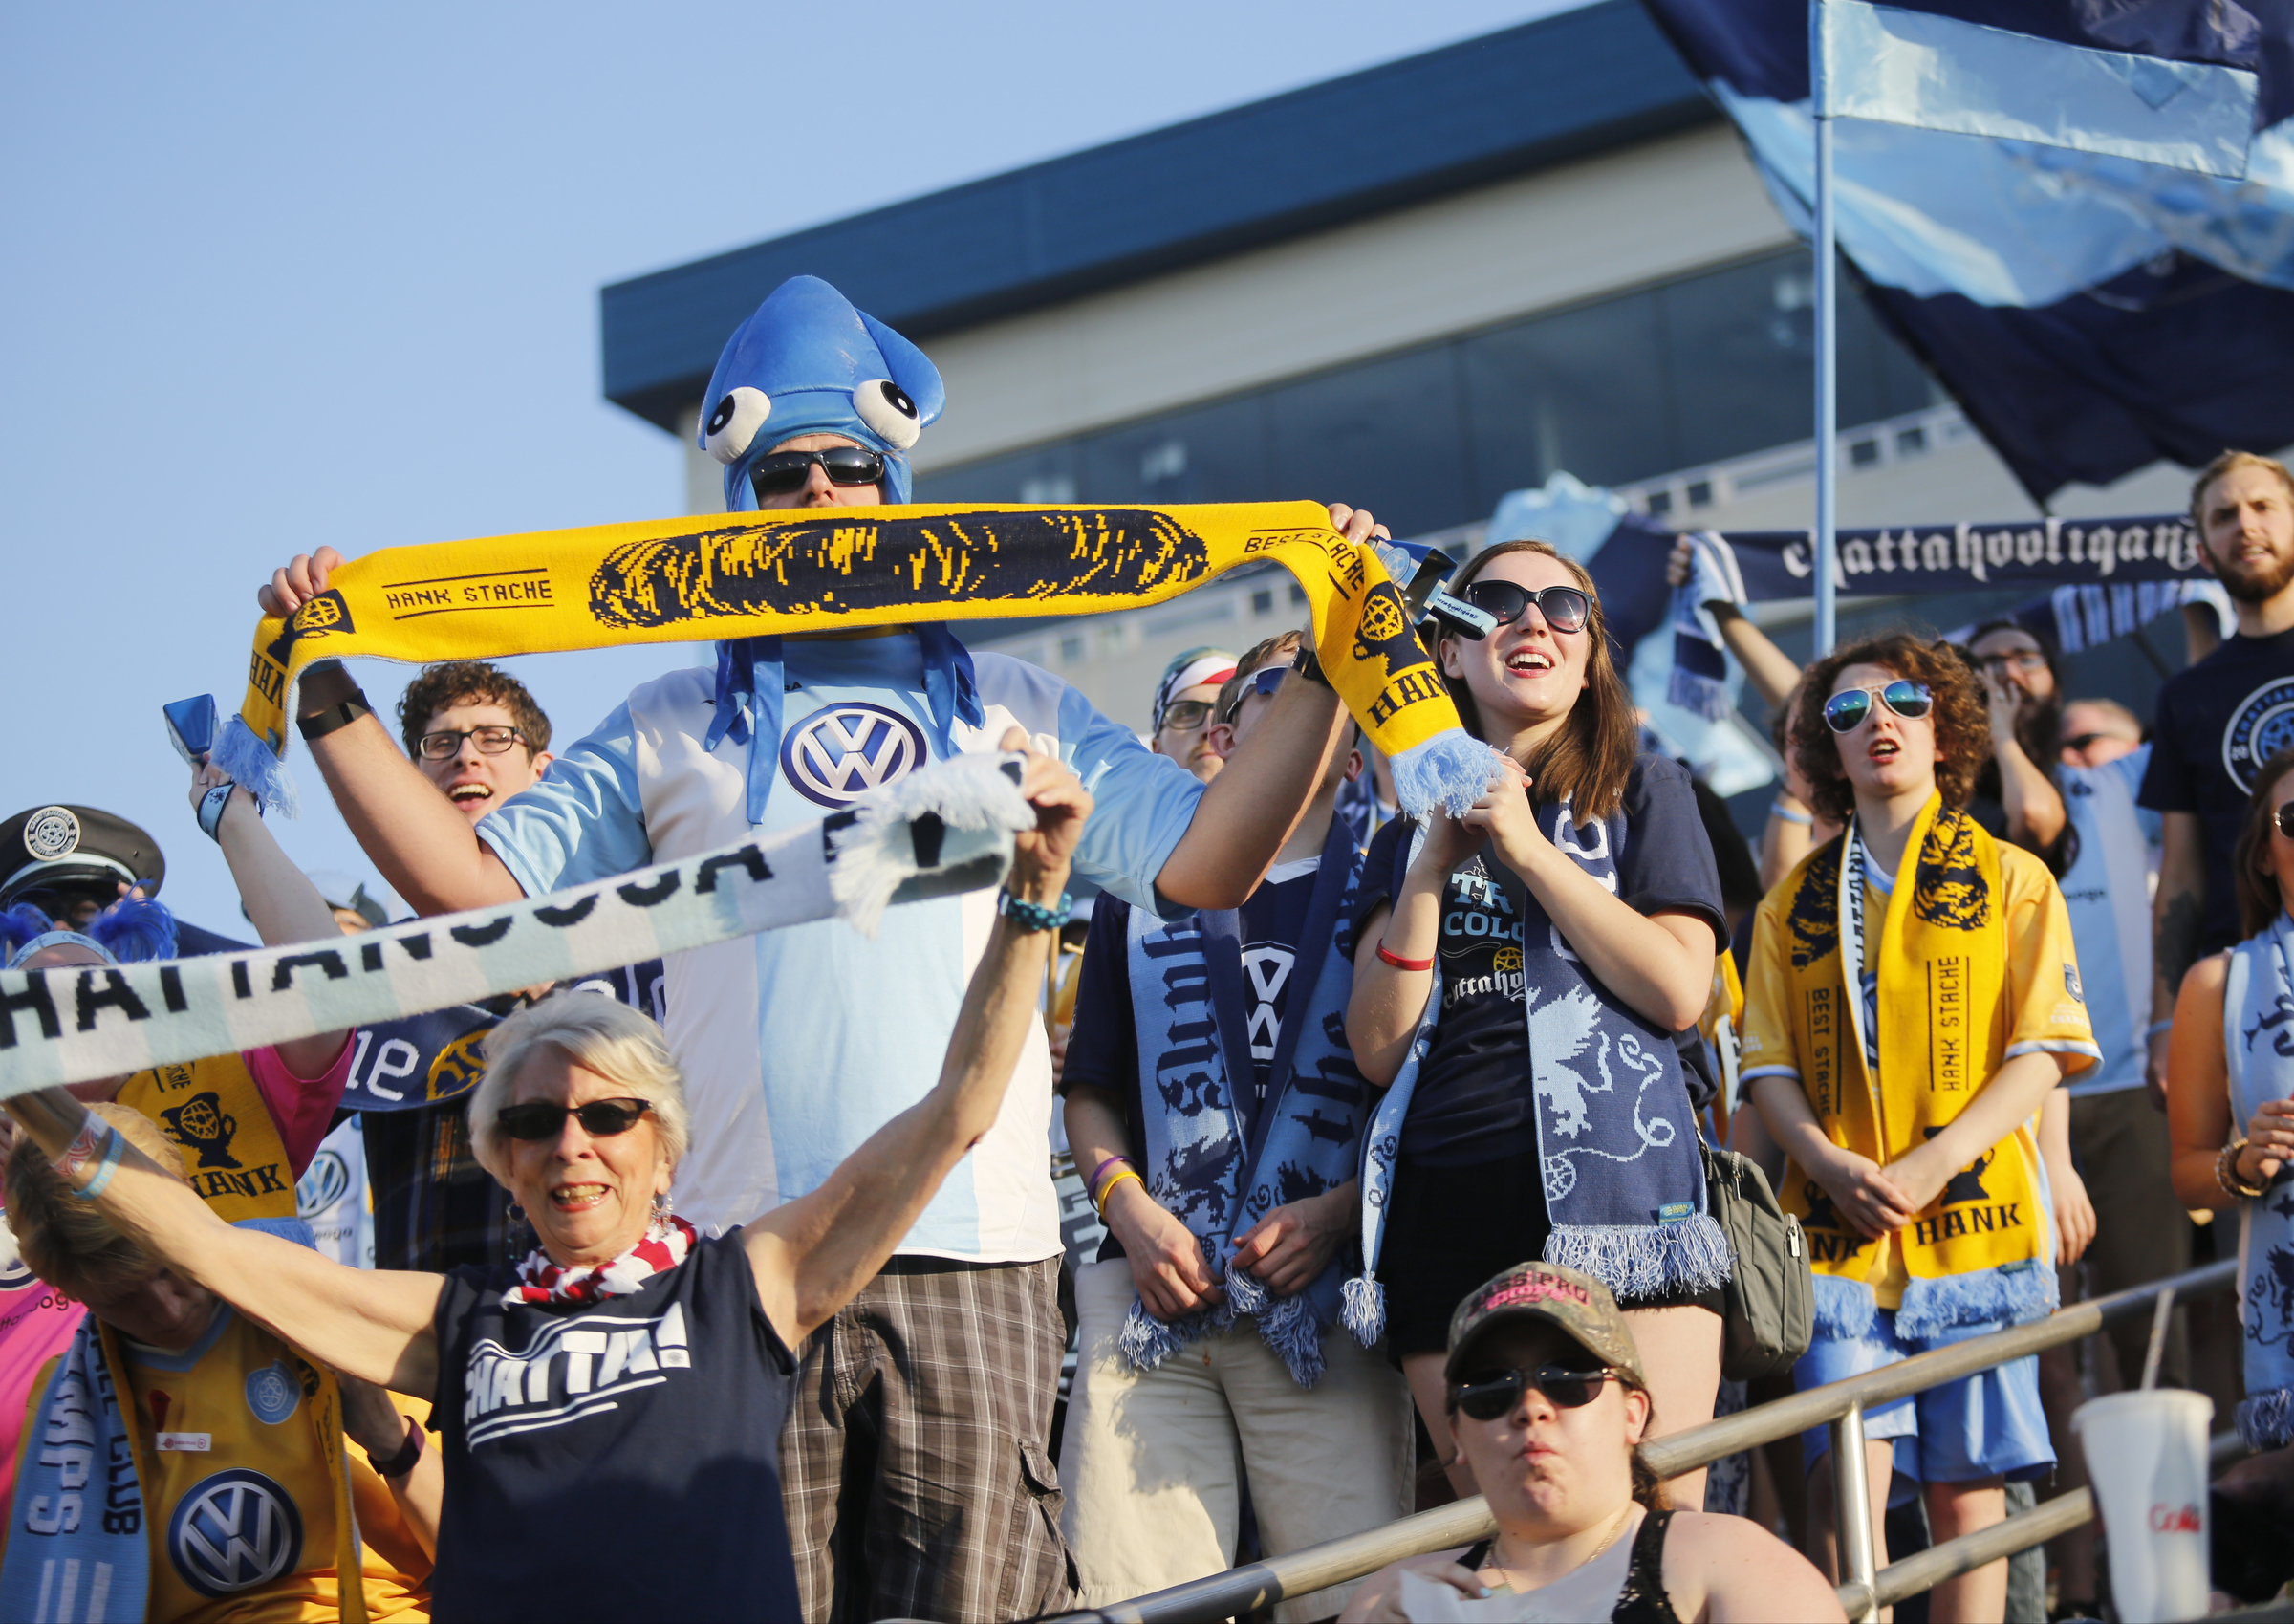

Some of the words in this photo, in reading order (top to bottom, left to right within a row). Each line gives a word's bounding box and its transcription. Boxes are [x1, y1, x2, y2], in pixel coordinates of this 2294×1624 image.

[385, 588, 453, 610] HANK
[465, 579, 553, 602] STACHE
[1812, 987, 1830, 1035] BEST
[1937, 956, 1960, 1028] STACHE
[1815, 1046, 1831, 1117] STACHE
[1939, 1038, 1960, 1092] HANK
[1915, 1202, 2023, 1248] HANK
